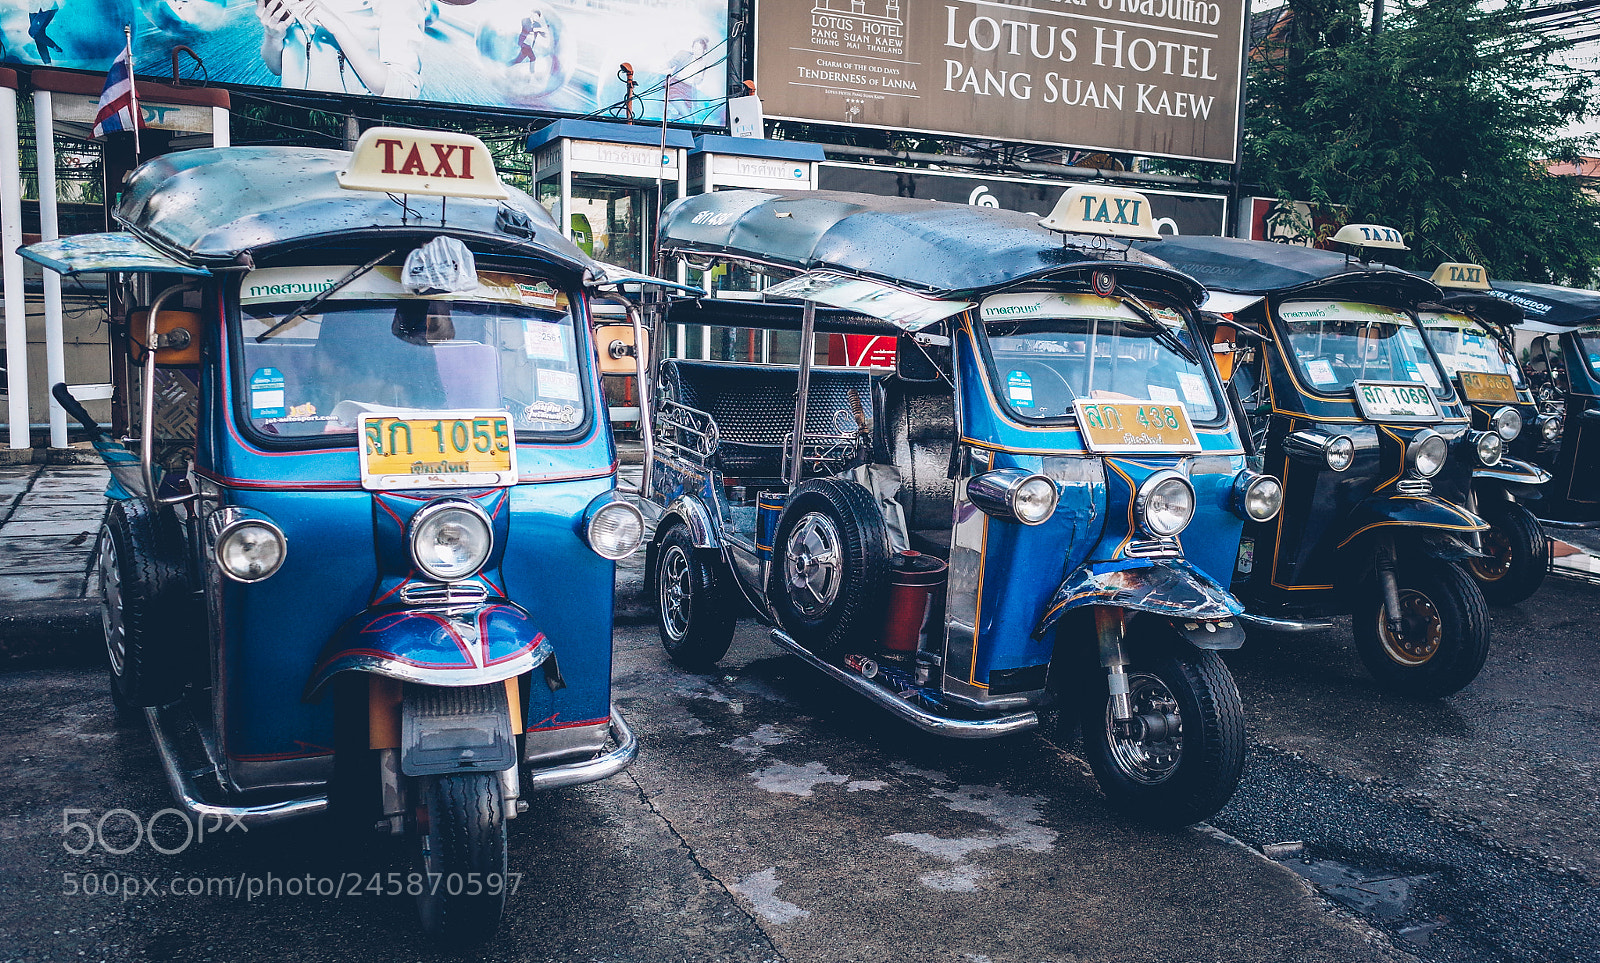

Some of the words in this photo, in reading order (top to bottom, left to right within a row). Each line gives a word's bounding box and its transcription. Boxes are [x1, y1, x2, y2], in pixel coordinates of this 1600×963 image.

[811, 14, 853, 31] LOTUS
[862, 21, 904, 38] HOTEL
[811, 28, 838, 40] PANG
[843, 32, 870, 43] SUAN
[875, 36, 903, 47] KAEW
[811, 37, 840, 47] CHIANG
[846, 41, 860, 50] MAI
[866, 44, 903, 55] THAILAND
[943, 5, 1078, 62] LOTUS
[1092, 26, 1218, 81] HOTEL
[816, 58, 842, 69] CHARM
[843, 62, 853, 70] OF
[854, 63, 867, 72] THE
[868, 65, 883, 73] OLD
[884, 67, 900, 75] DAYS
[797, 66, 867, 85] TENDERNESS
[868, 78, 879, 86] OF
[882, 76, 918, 91] LANNA
[943, 58, 1031, 100] PANG
[1044, 71, 1124, 111] SUAN
[1135, 83, 1215, 121] KAEW
[375, 138, 475, 180] TAXI
[1080, 195, 1142, 226] TAXI
[1360, 226, 1402, 244] TAXI
[1449, 266, 1481, 283] TAXI
[250, 278, 339, 297] กาดสวนแก้
[1508, 294, 1553, 312] KINGDOM
[1391, 387, 1430, 405] 1069
[265, 414, 339, 425] jet-autosport.com
[1136, 405, 1180, 431] 438
[431, 420, 510, 454] 1055
